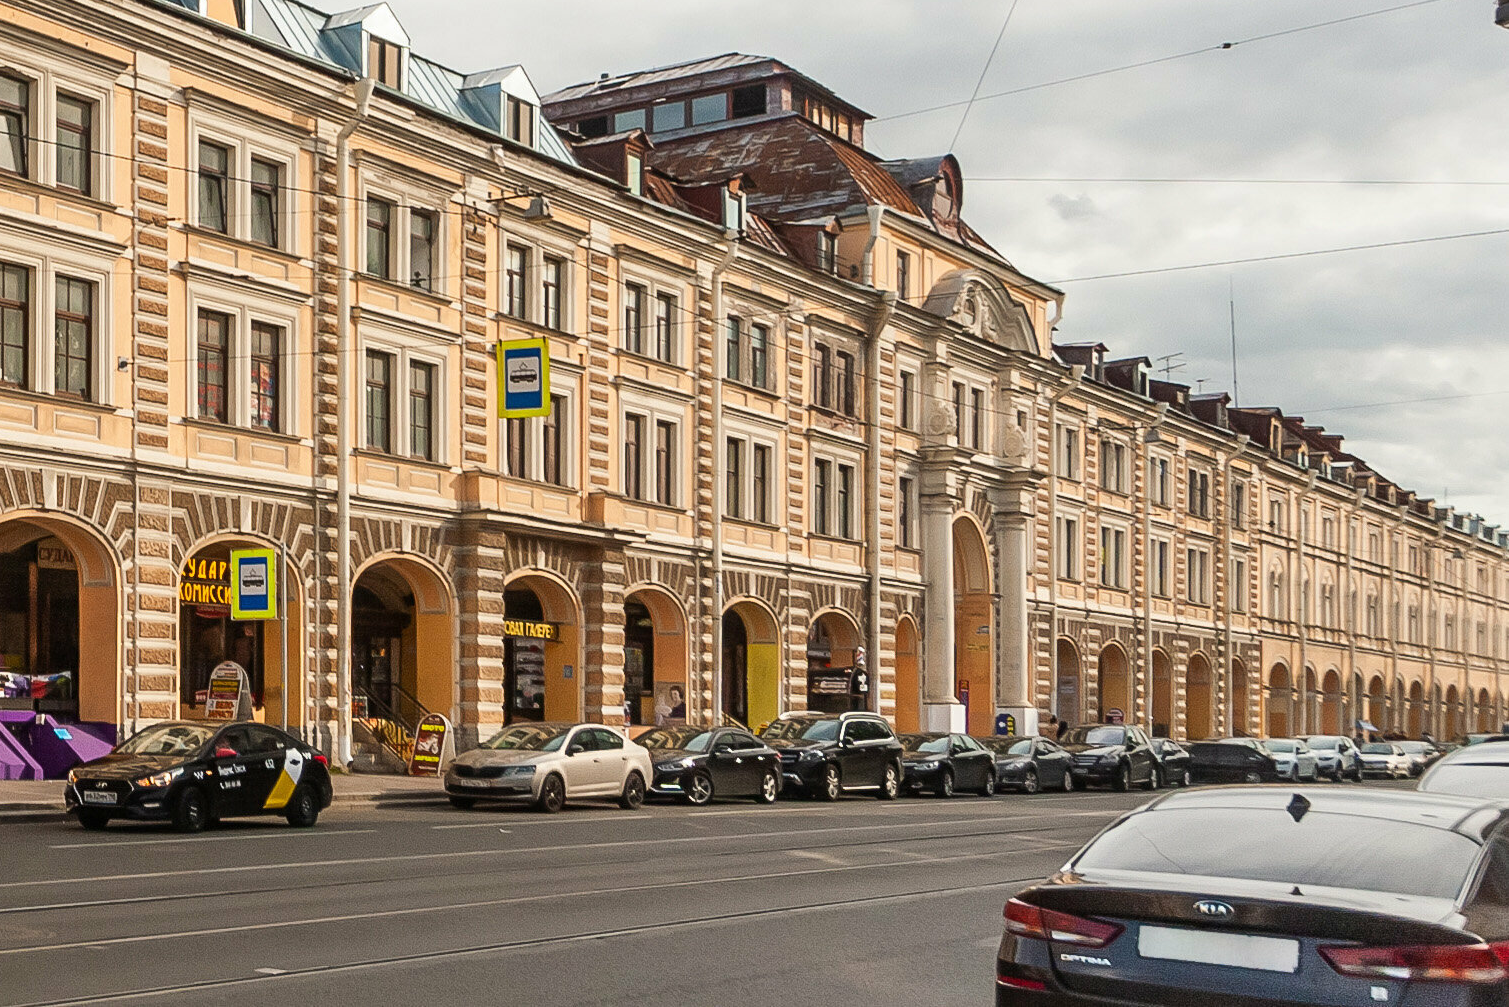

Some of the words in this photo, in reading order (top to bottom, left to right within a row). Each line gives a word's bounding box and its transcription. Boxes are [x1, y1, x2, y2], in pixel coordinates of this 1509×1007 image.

[182, 558, 227, 580] УДАР
[1199, 903, 1227, 915] KIA
[1060, 953, 1112, 966] OPTIMA
